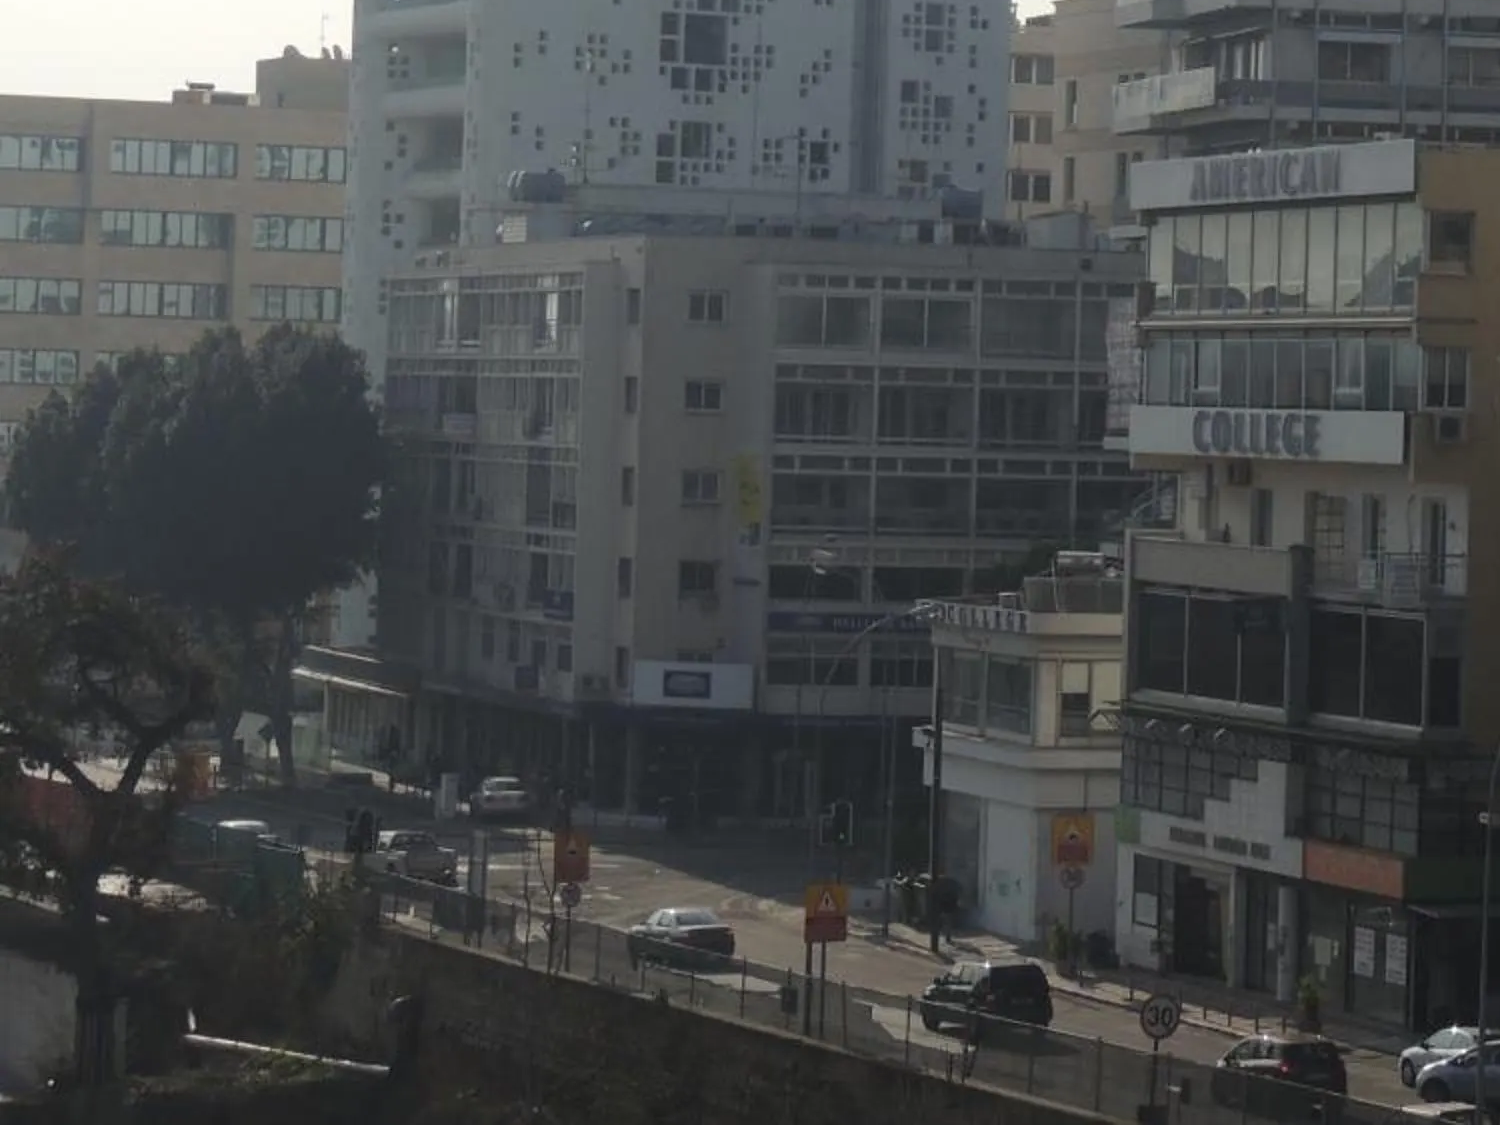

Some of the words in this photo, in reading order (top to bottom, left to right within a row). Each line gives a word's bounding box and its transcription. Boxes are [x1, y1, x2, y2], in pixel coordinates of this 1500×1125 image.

[1190, 150, 1341, 202] AMERICAN
[1194, 410, 1320, 457] COLLEGE
[1147, 1006, 1173, 1027] 30
